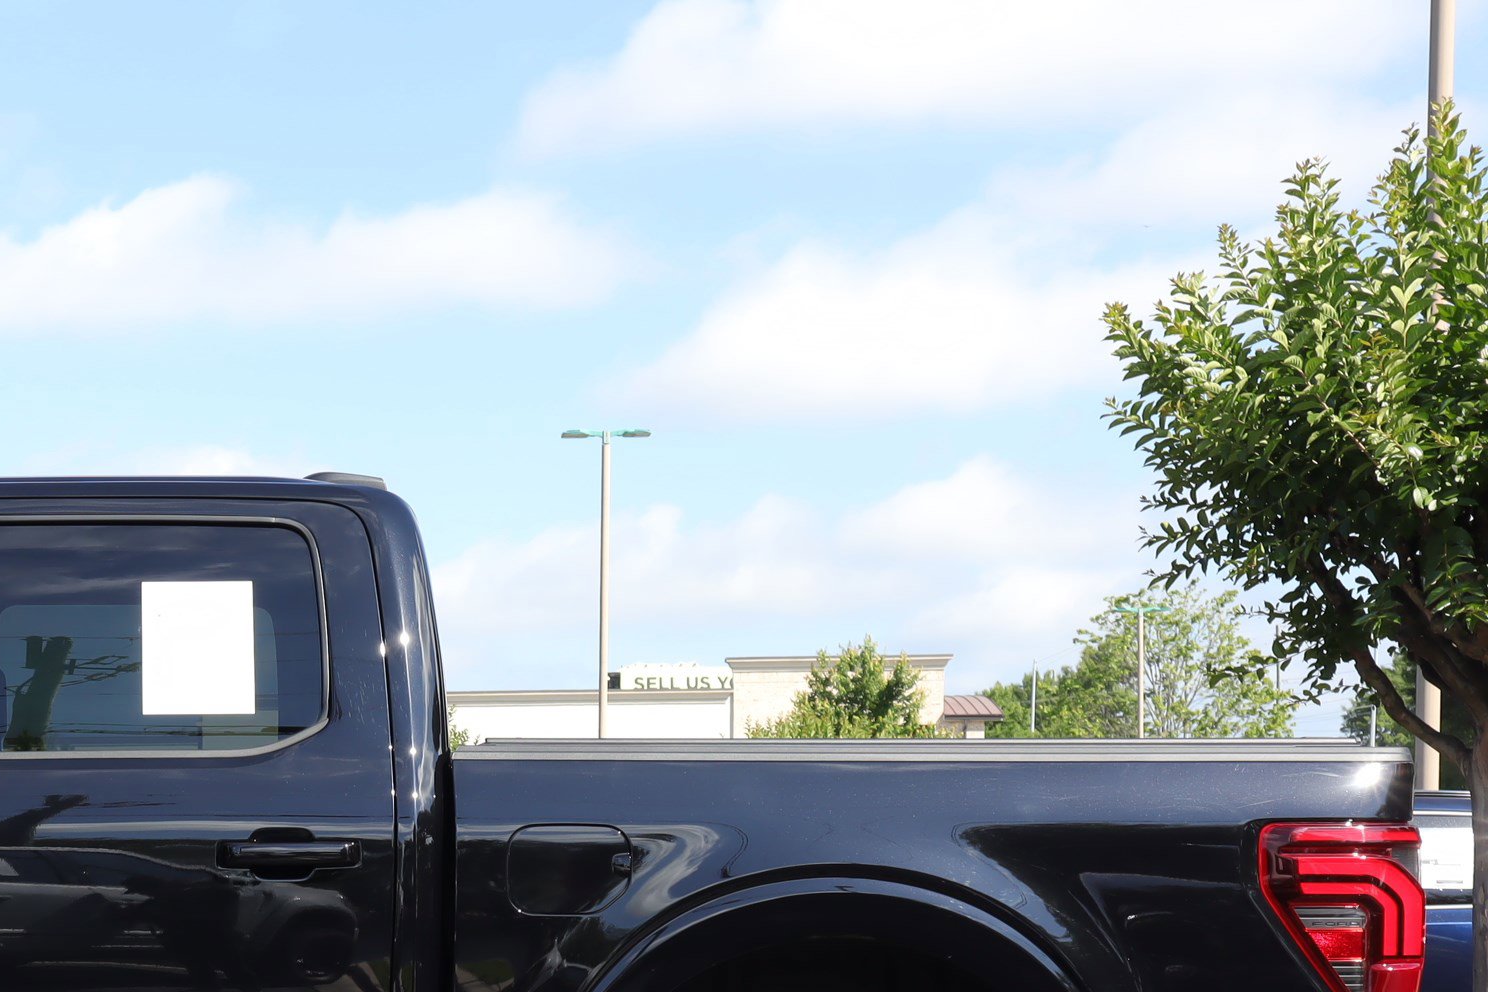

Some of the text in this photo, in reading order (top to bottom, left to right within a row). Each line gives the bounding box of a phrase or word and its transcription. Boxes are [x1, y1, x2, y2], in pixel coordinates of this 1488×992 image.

[634, 676, 734, 690] SELL US Y
